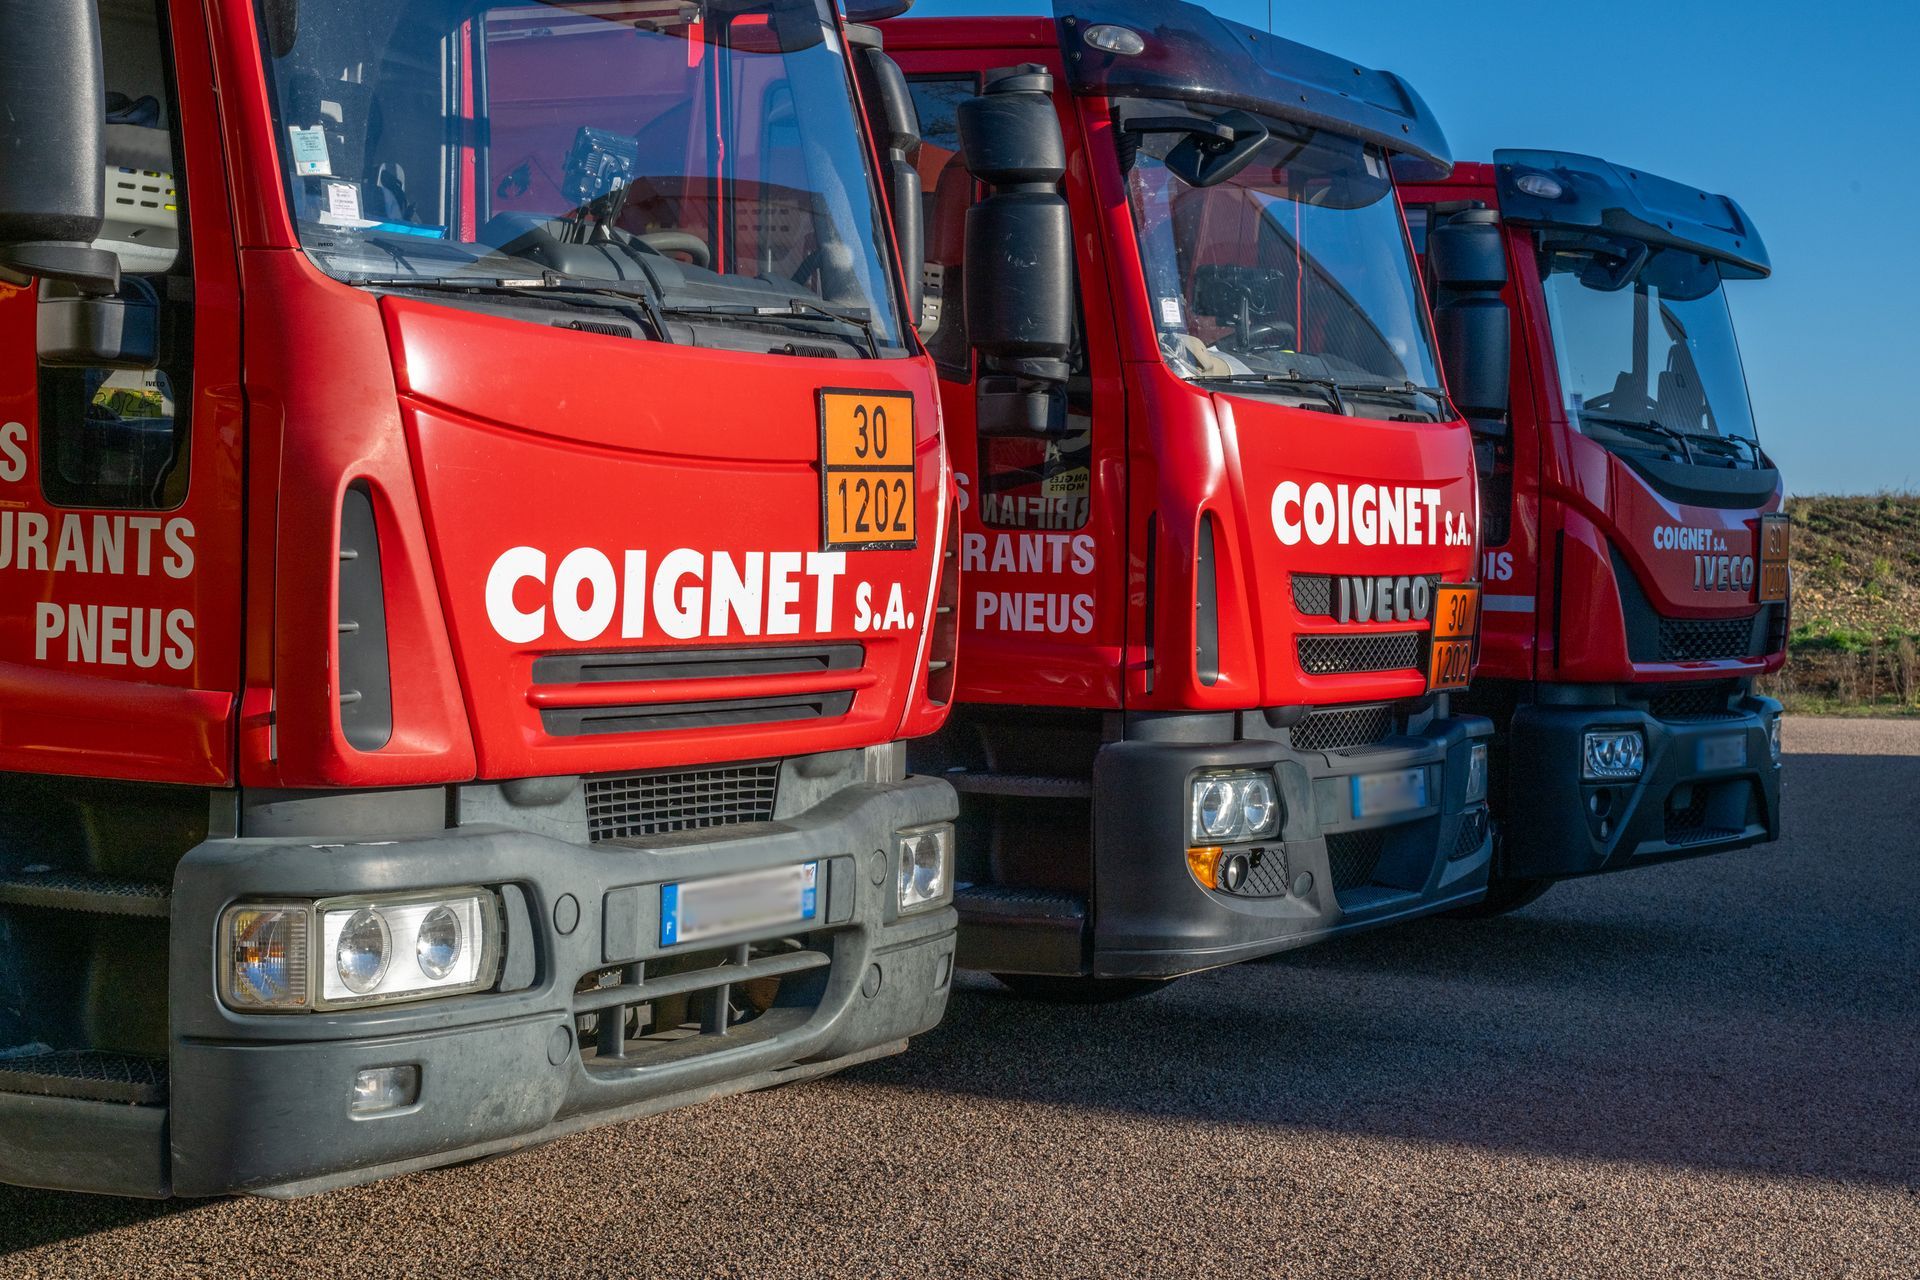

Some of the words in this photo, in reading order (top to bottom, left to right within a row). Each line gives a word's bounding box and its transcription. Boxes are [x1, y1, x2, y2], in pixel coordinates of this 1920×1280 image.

[854, 405, 888, 459] 30
[839, 479, 907, 535] 1202
[1271, 480, 1441, 546] COIGNET
[1445, 511, 1471, 547] S.A.
[1653, 525, 1712, 551] COIGNET
[1714, 538, 1727, 551] S.A.
[1481, 551, 1514, 581] IS
[1694, 556, 1754, 591] IVECO
[485, 546, 846, 644] COIGNET
[854, 582, 915, 633] S.A.
[976, 592, 1094, 633] PNEUS
[1338, 576, 1430, 624] IVECO
[1450, 595, 1467, 632] 30
[35, 602, 195, 670] PNEUS
[1436, 644, 1469, 684] 1202
